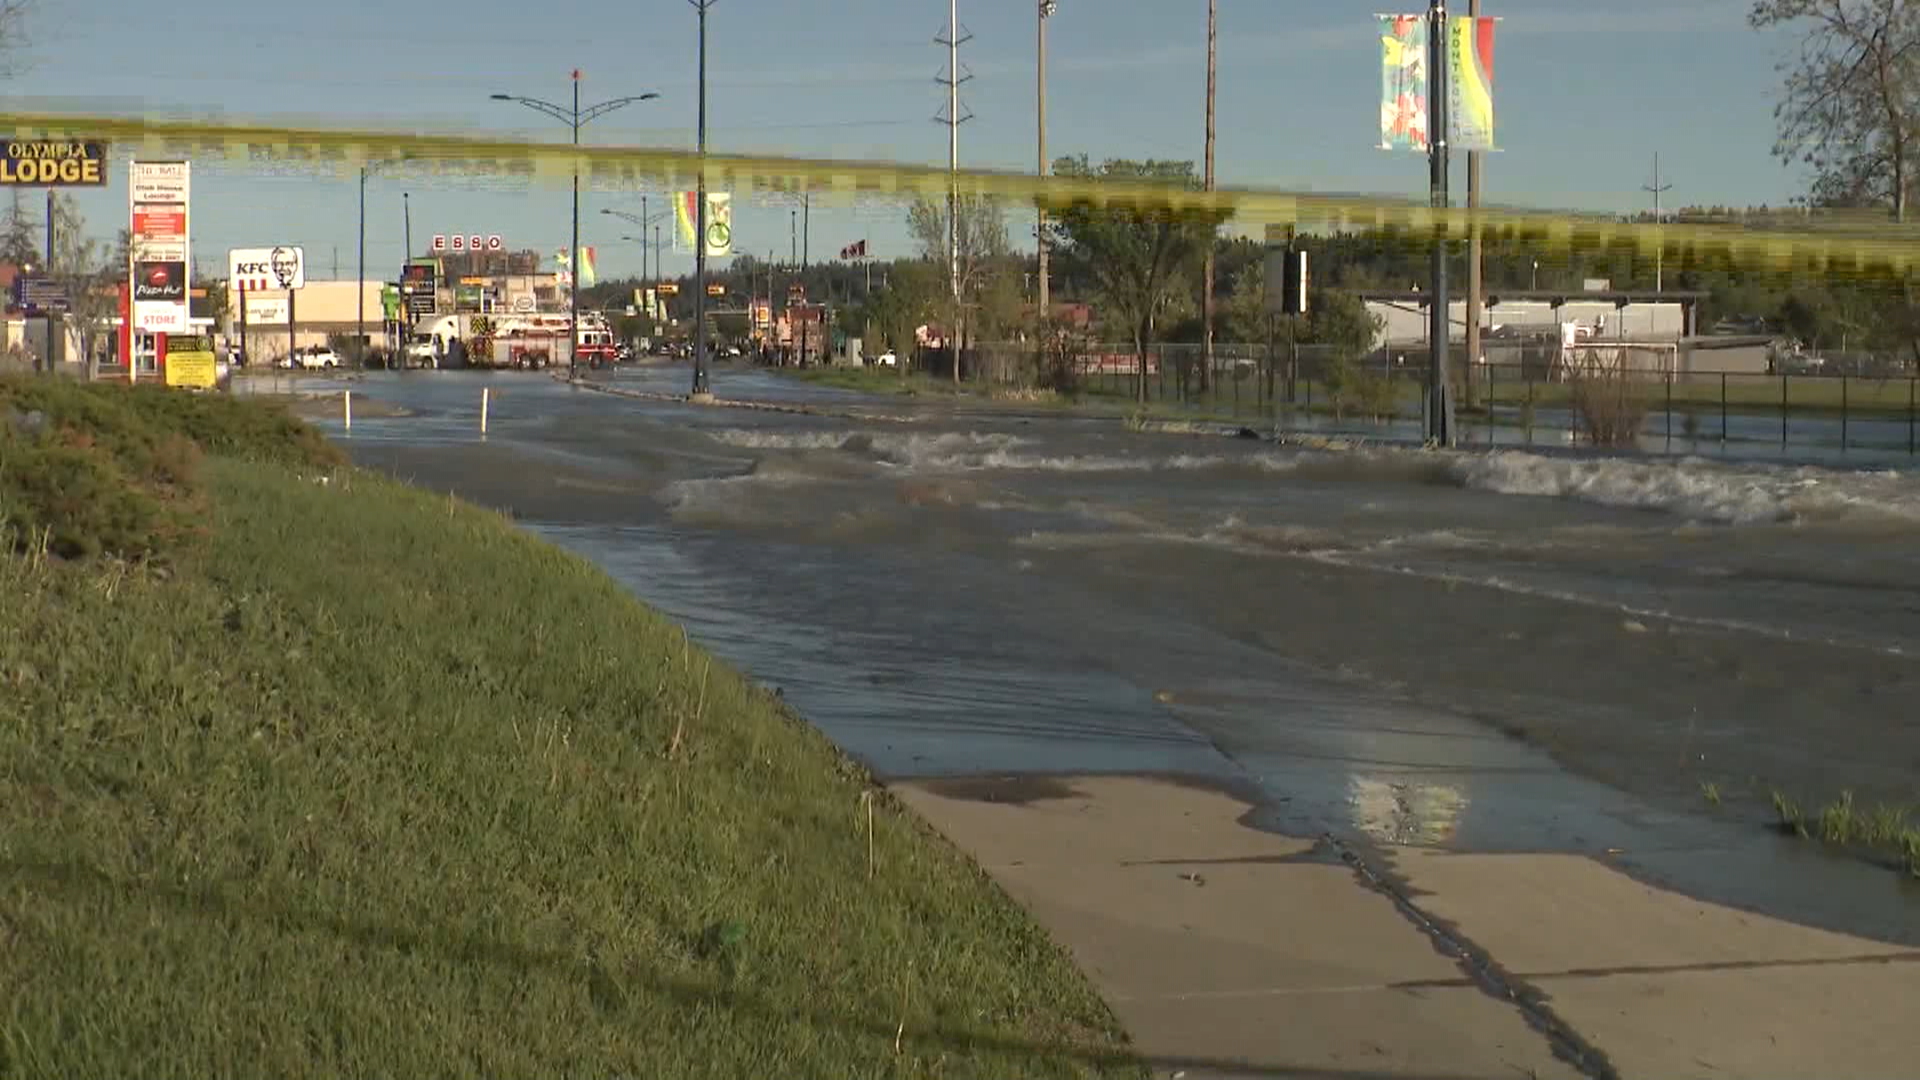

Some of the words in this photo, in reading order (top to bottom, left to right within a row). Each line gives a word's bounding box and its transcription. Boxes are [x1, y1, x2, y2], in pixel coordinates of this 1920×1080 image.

[8, 142, 89, 158] OLYMPIA
[0, 159, 100, 182] LODGE
[434, 236, 501, 249] ESSO
[236, 262, 269, 275] KFC
[143, 315, 177, 325] STORE
